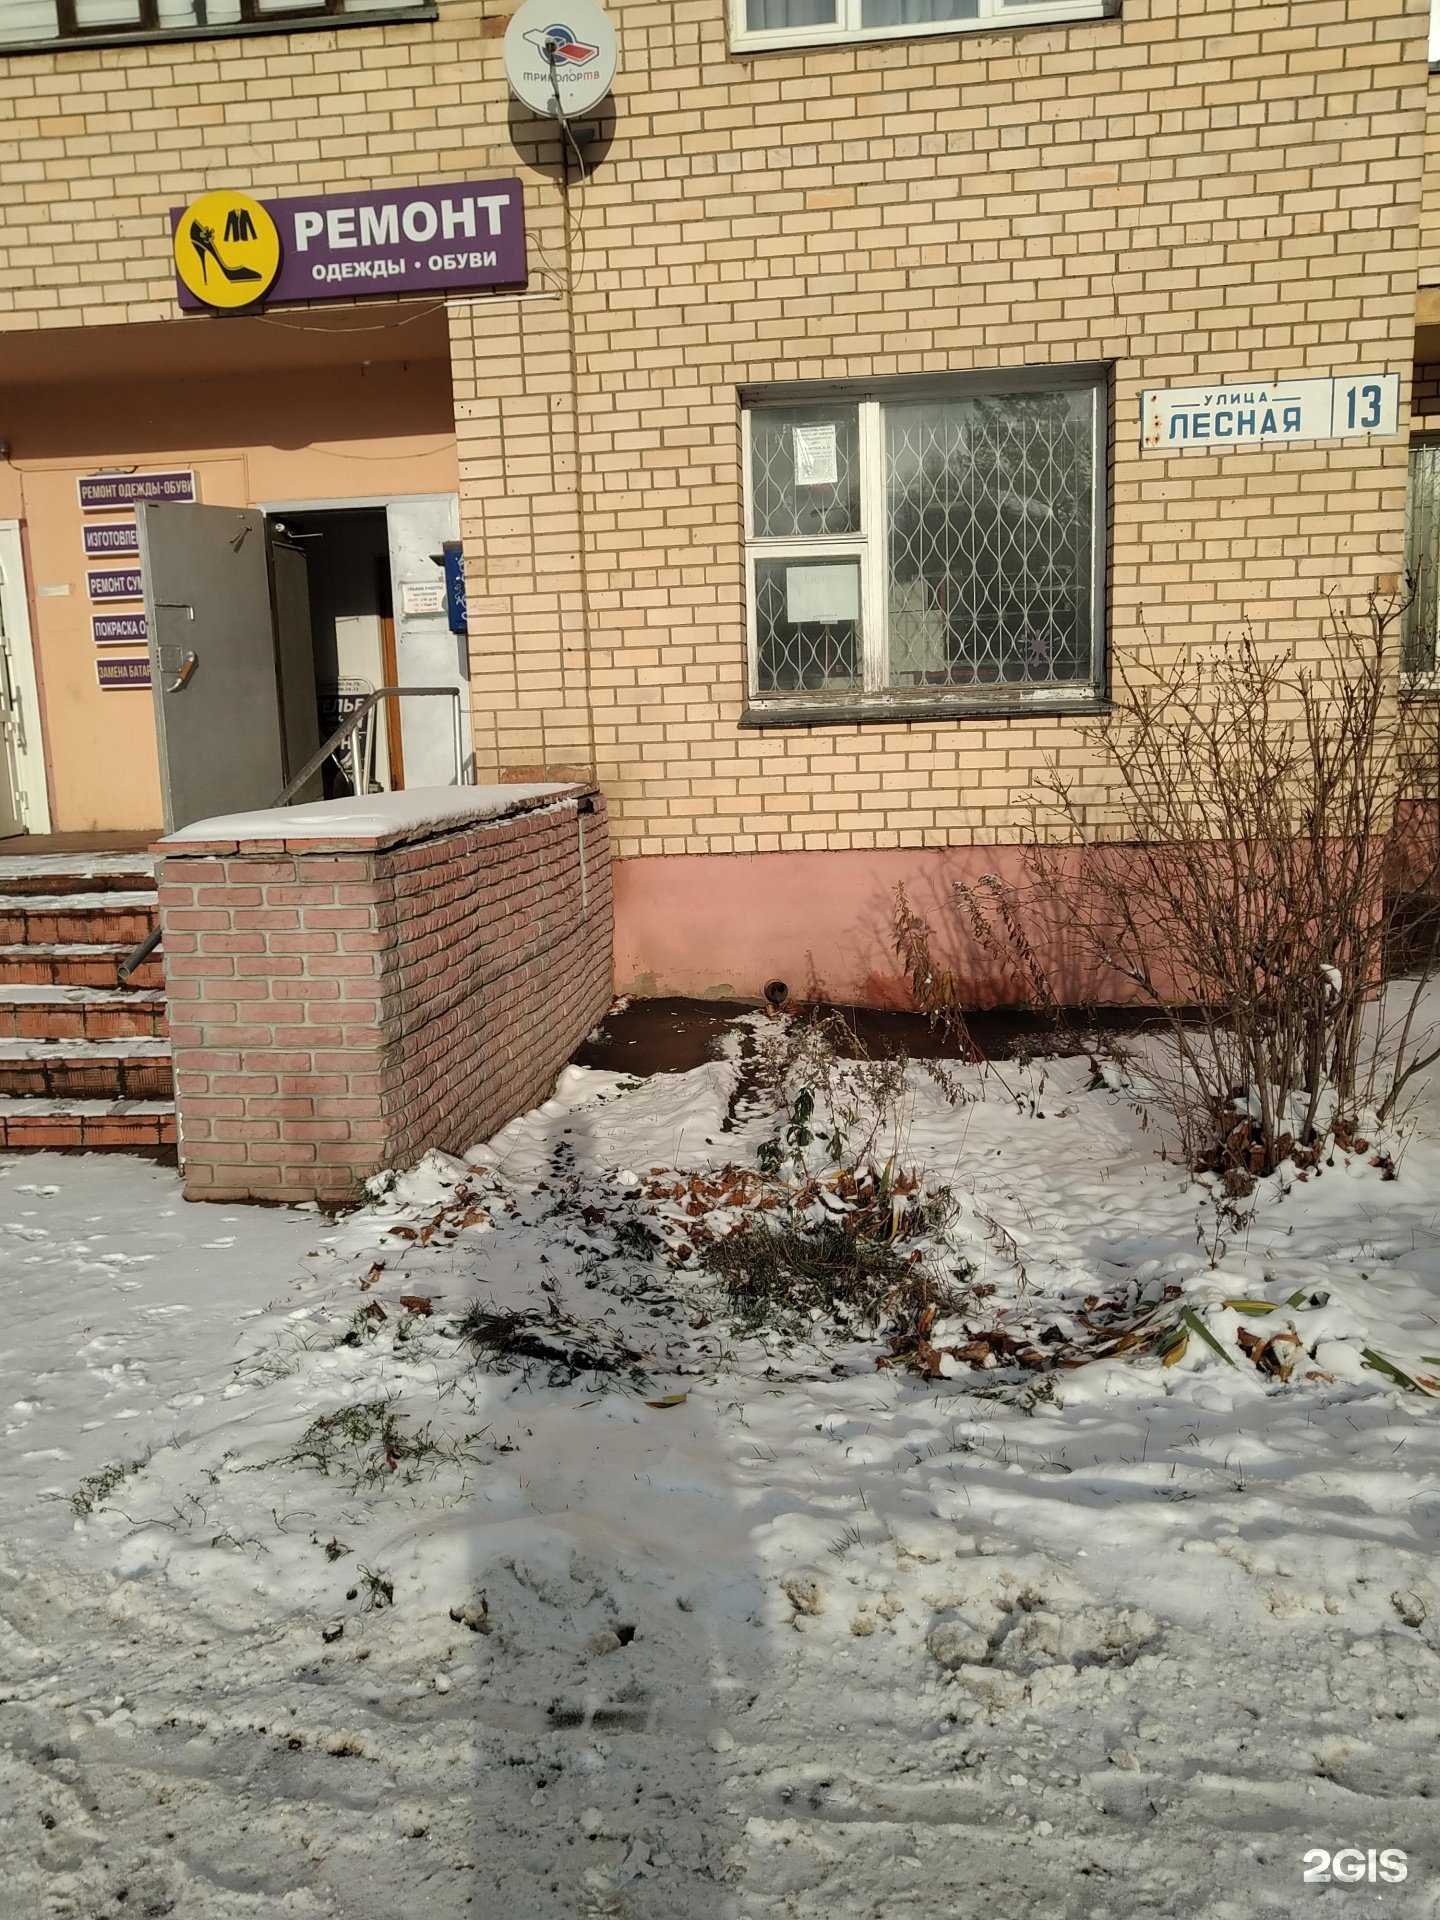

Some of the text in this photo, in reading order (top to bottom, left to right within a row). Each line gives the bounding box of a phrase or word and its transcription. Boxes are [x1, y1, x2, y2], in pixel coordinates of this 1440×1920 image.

[294, 195, 511, 252] РЕМОНТ
[311, 251, 498, 283] ОДЕЖДЫ ОБУВИ
[1204, 391, 1268, 406] УЛИЦА
[1169, 384, 1382, 440] ЛЕСНАЯ 13
[82, 484, 117, 499] РЕМОНТ
[86, 530, 138, 547] ИЗГОТОВЛЕ
[90, 576, 126, 593] РЕМОНТ
[95, 621, 138, 637] ПОКРАСКА
[99, 666, 128, 679] ЗАМЕНА
